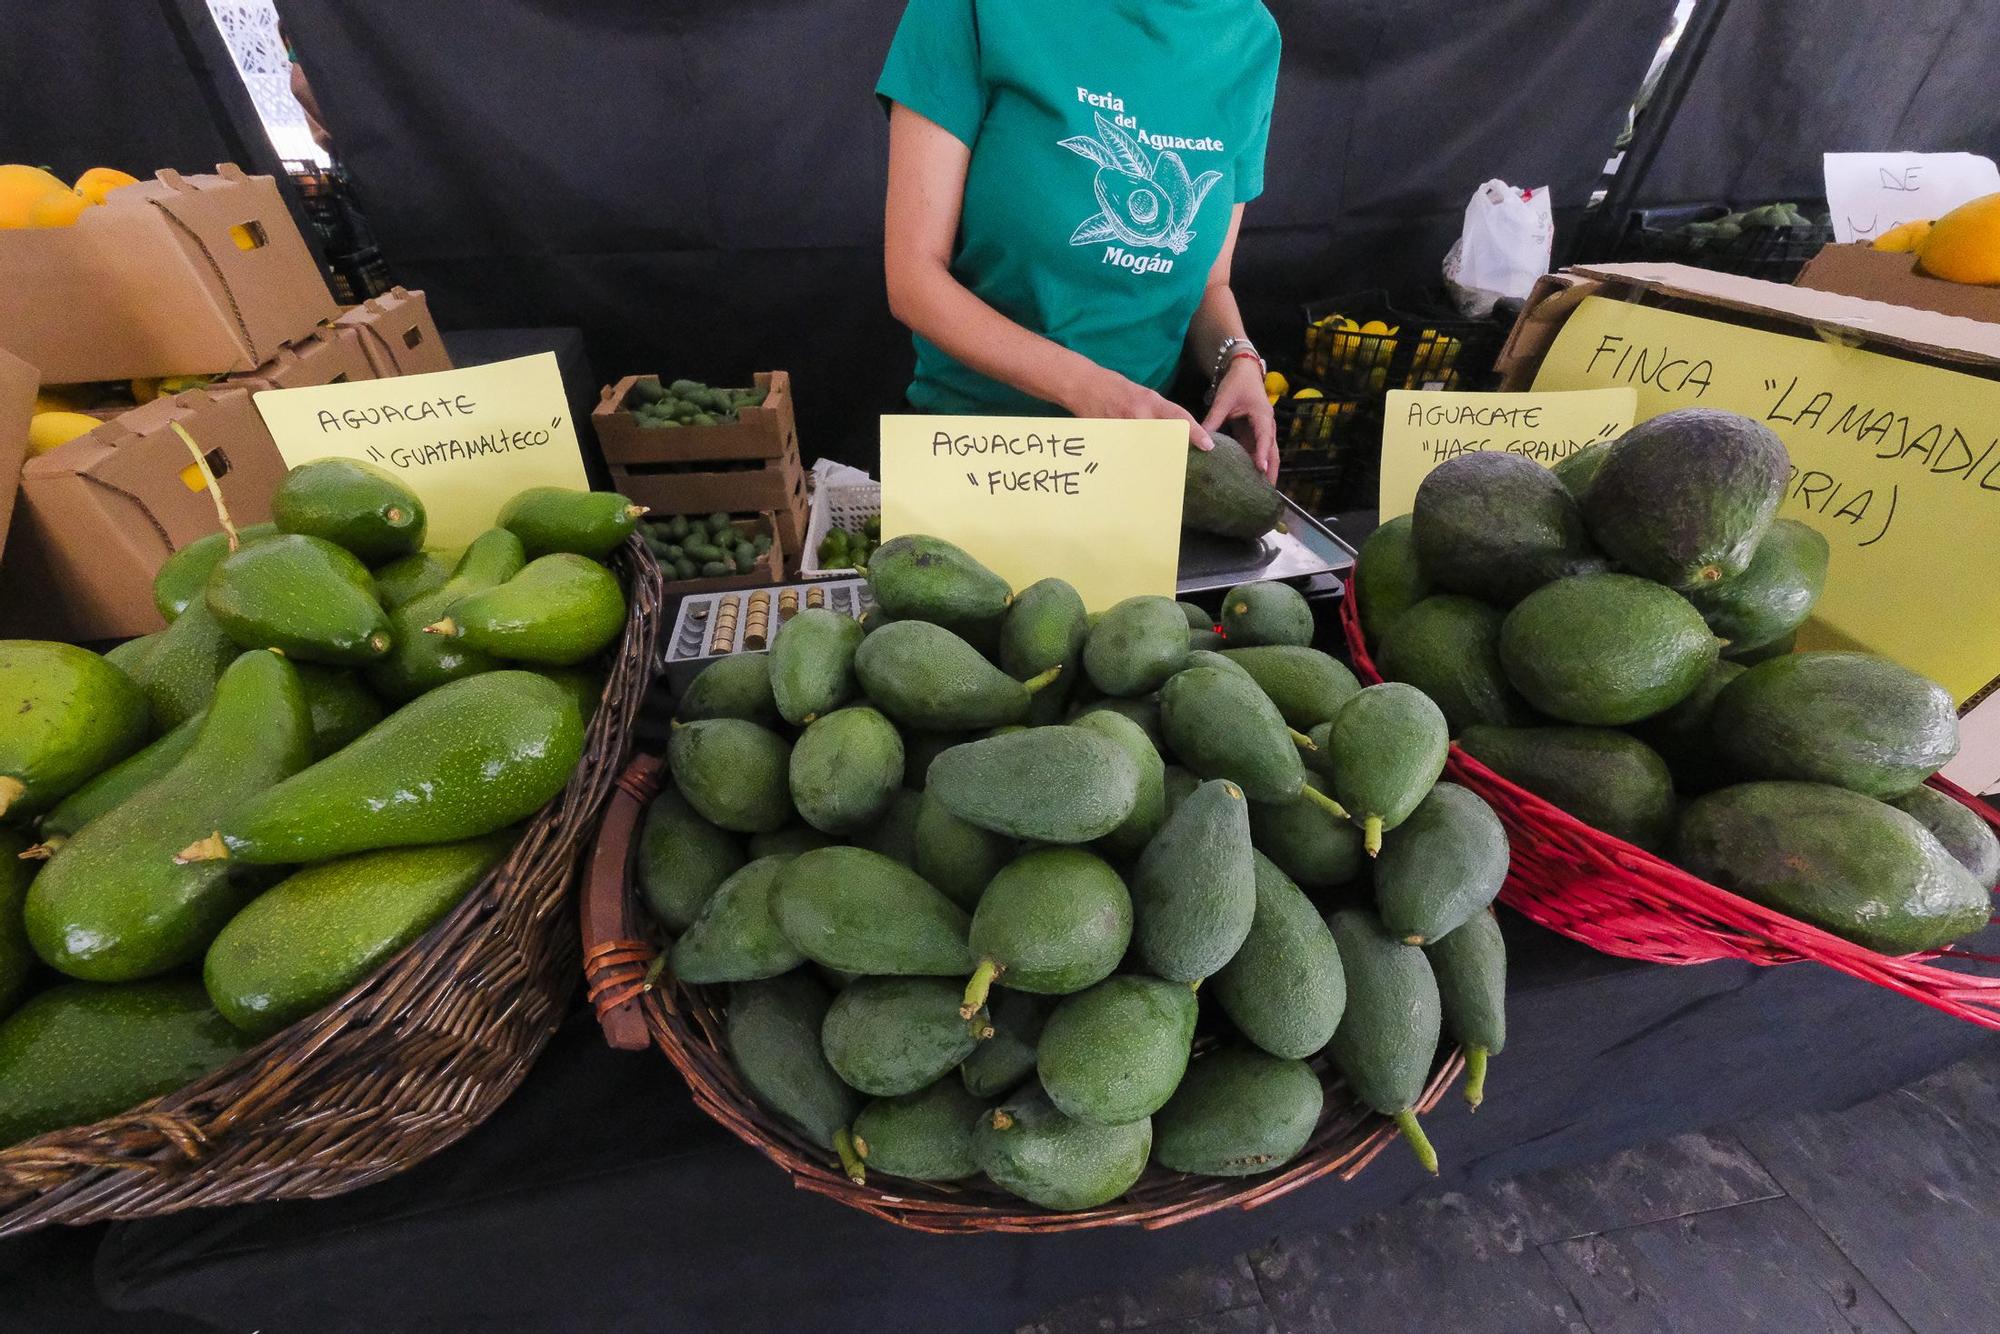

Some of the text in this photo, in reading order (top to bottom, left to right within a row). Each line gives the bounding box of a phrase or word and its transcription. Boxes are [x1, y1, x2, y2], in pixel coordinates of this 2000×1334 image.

[1076, 86, 1124, 113] Feria
[1114, 114, 1137, 130] del
[1137, 129, 1224, 152] Aguacate
[1102, 246, 1174, 275] Mogán
[1586, 335, 1713, 398] FINCA
[317, 395, 476, 433] AGUACATE
[1407, 402, 1543, 428] AGUACATE
[933, 431, 1086, 457] AGUACATE
[967, 462, 1099, 495] "FUERTE"
